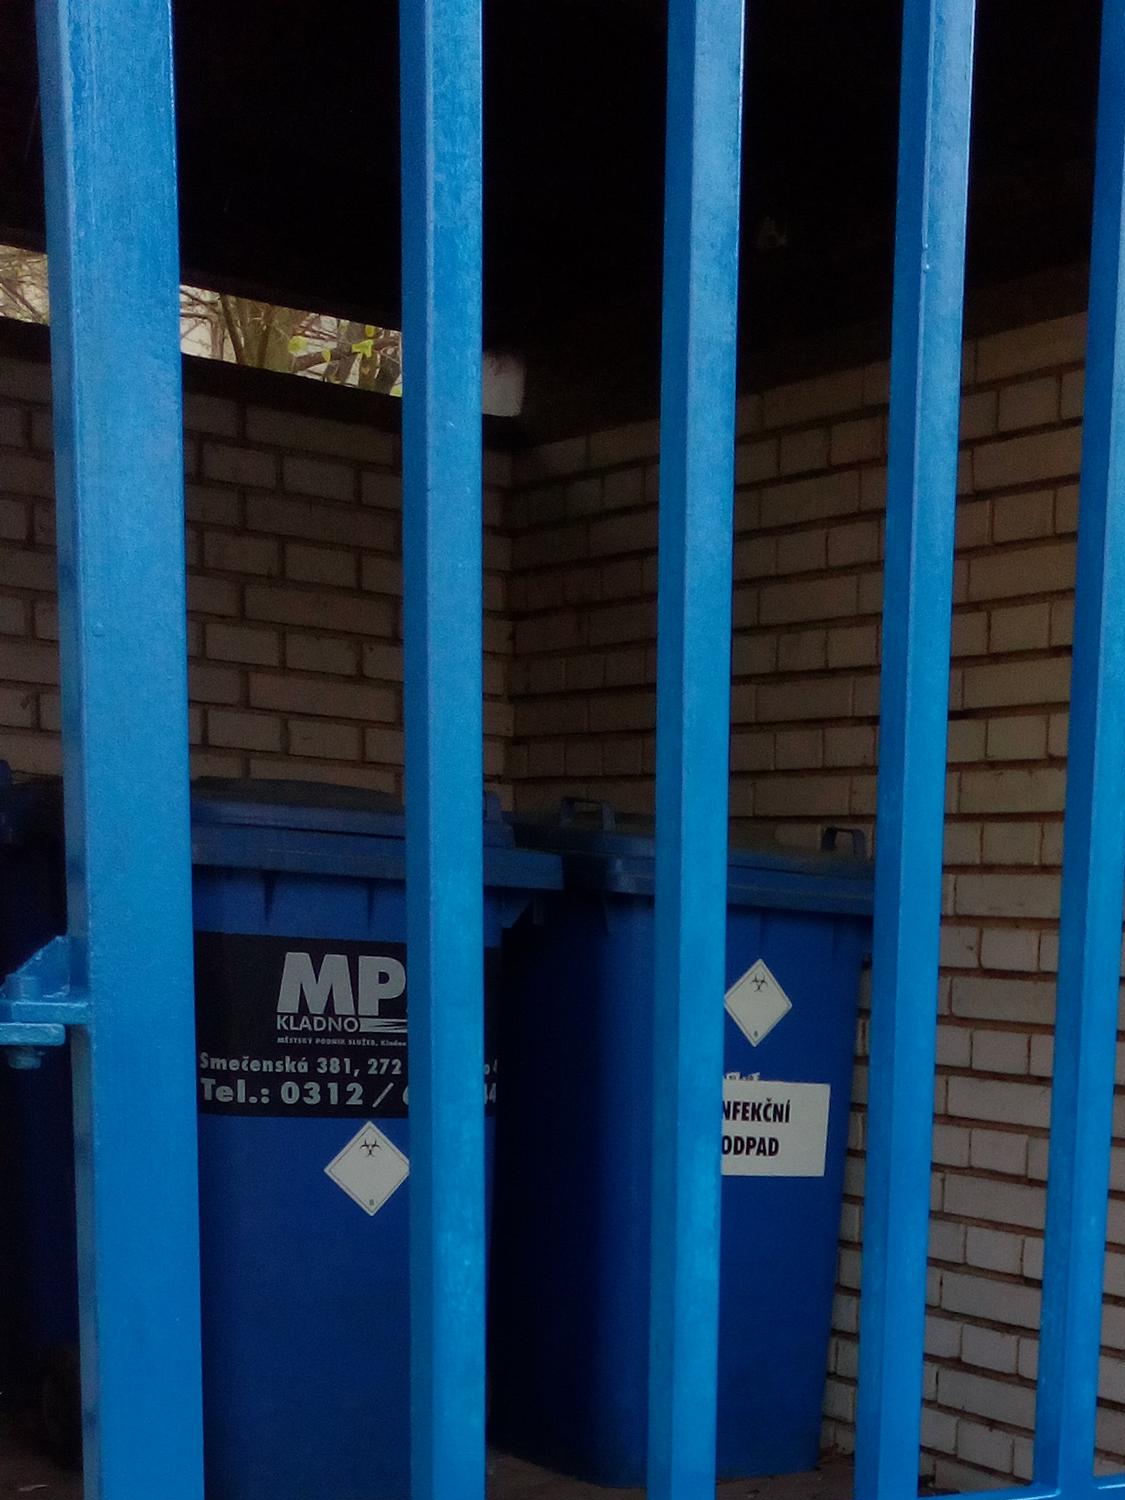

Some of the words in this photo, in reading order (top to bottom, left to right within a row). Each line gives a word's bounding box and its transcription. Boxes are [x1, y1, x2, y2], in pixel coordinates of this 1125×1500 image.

[276, 1015, 360, 1033] KLADNO
[200, 1052, 309, 1073] Smečenská
[316, 1057, 360, 1077] 381,
[367, 1058, 402, 1075] 272
[200, 1077, 270, 1104] Tel.:
[280, 1081, 364, 1105] 0312
[721, 1135, 779, 1156] ODPAD
